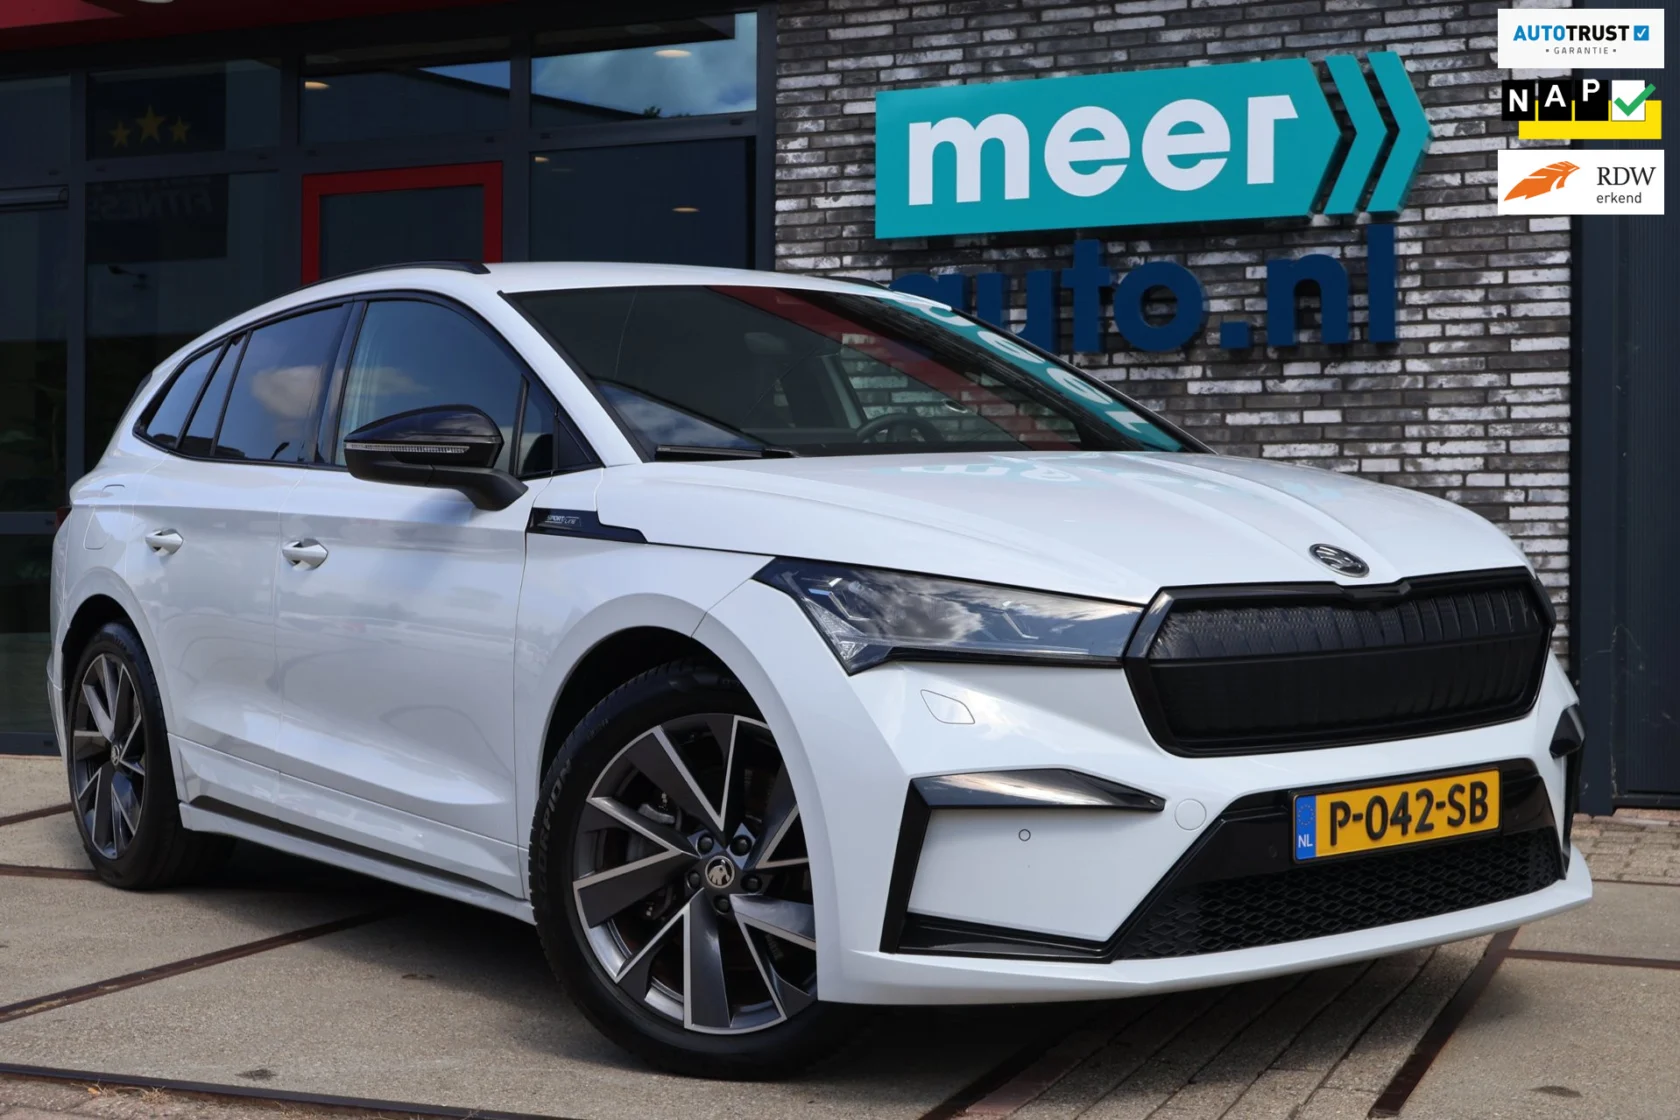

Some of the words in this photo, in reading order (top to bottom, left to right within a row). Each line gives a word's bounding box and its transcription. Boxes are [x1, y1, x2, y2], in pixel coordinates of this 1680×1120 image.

[908, 93, 1300, 207] meer
[1297, 834, 1314, 848] NL
[1329, 780, 1489, 847] P-042-SB
